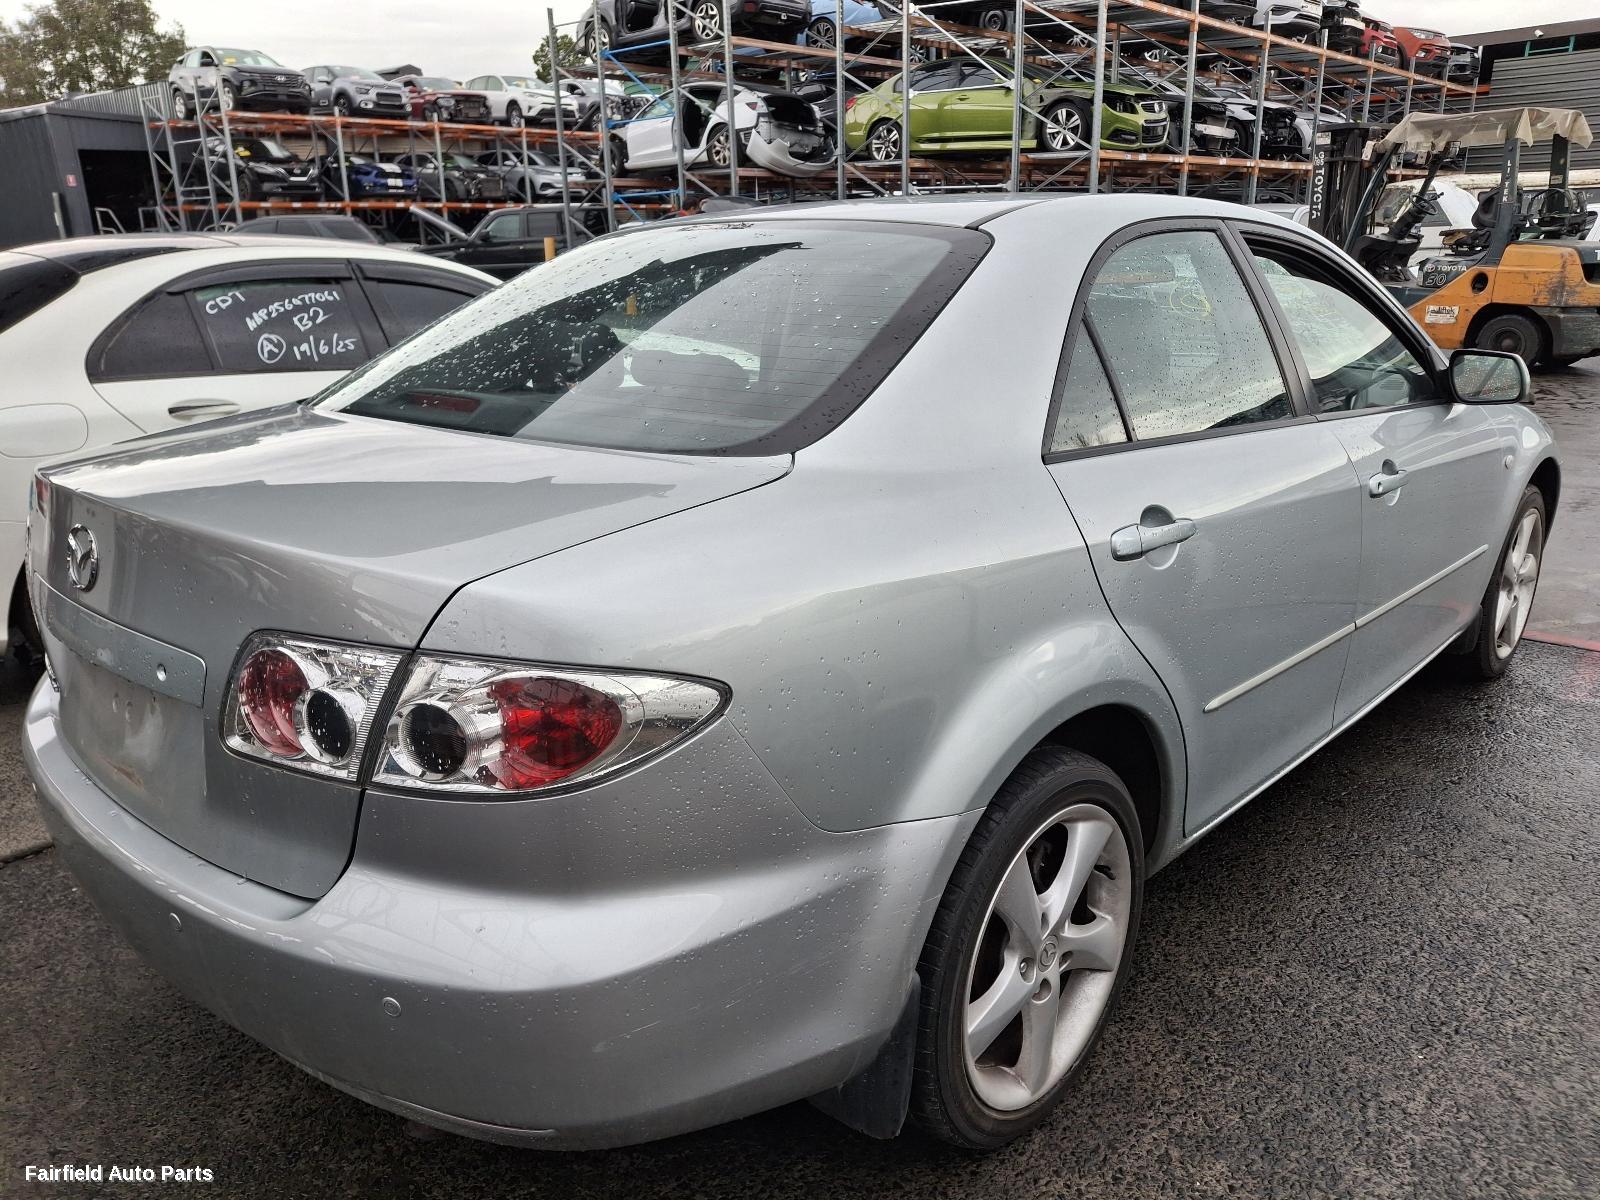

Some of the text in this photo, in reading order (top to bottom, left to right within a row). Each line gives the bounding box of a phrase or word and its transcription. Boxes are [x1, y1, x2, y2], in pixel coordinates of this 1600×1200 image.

[1311, 167, 1325, 219] TOYOTA
[292, 306, 334, 332] B2
[293, 332, 357, 362] 19/6/25
